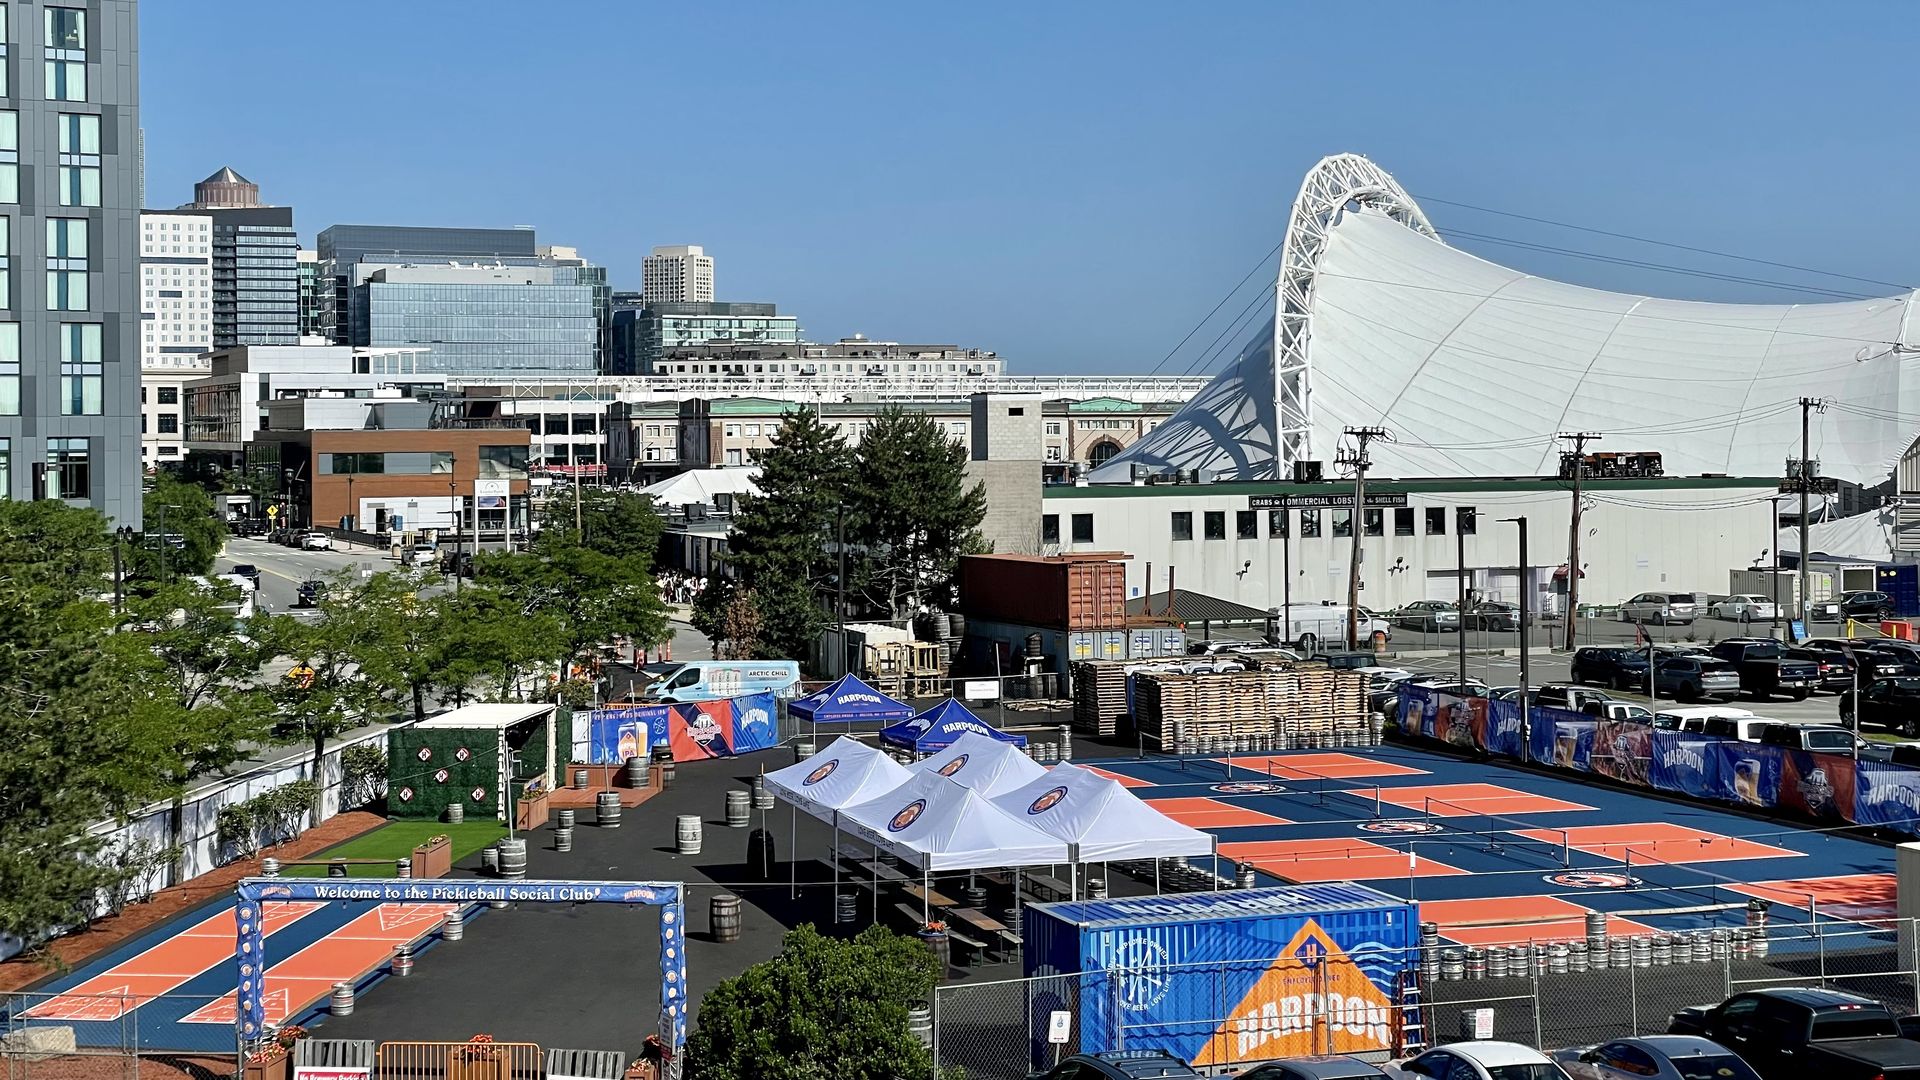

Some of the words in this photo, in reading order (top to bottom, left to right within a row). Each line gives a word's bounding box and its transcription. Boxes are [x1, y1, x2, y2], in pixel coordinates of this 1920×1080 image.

[837, 693, 882, 705] HARPOON
[741, 708, 769, 730] HARPOON
[942, 721, 990, 736] HARPOON
[1663, 749, 1704, 775] HARPOON
[1867, 784, 1920, 815] HARPOON
[314, 886, 382, 899] Welcome
[385, 887, 400, 899] to
[404, 885, 429, 899] the
[432, 886, 505, 900] Pickleball
[509, 886, 555, 900] Social
[624, 889, 656, 900] HARPOON
[1151, 992, 1166, 1007] LOVE
[1236, 992, 1391, 1057] HARPOON
